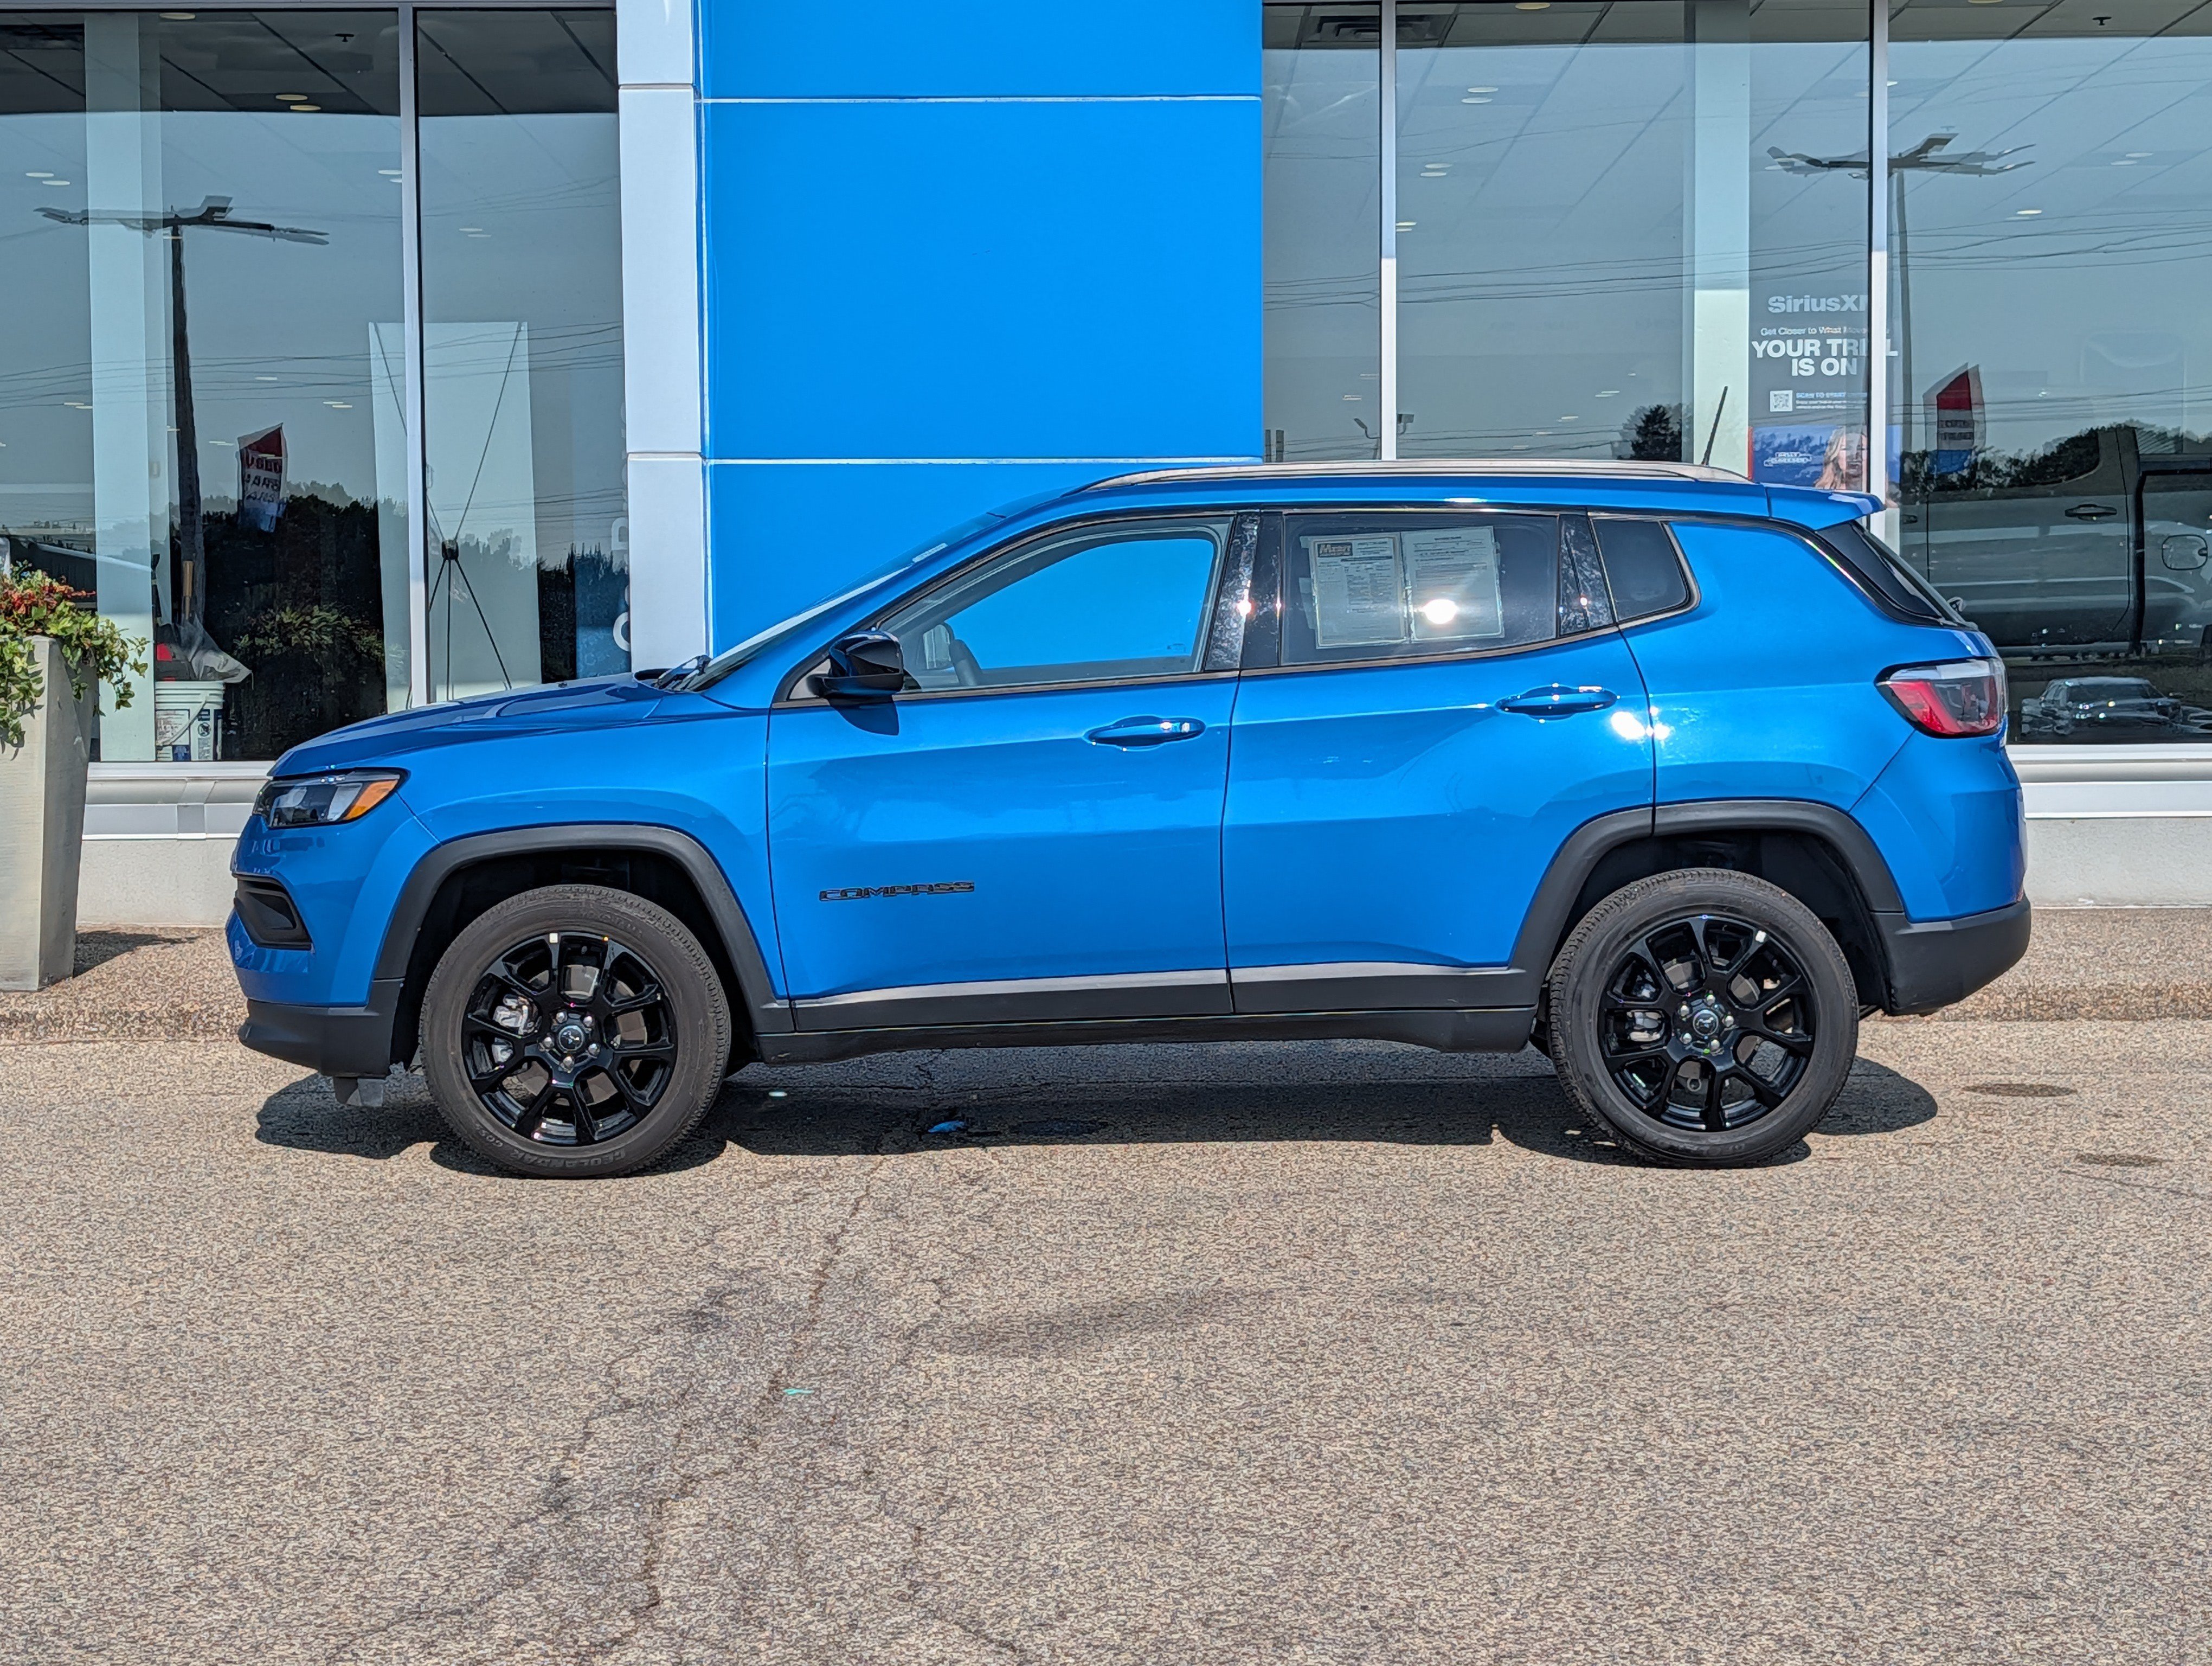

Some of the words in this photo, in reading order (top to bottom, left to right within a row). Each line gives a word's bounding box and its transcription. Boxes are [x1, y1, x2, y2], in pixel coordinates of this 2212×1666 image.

[1751, 339, 1821, 358] YOUR
[1826, 338, 1899, 357] TRIL
[1791, 358, 1815, 376] IS
[1820, 357, 1857, 376] ON
[819, 880, 975, 902] COMPASS
